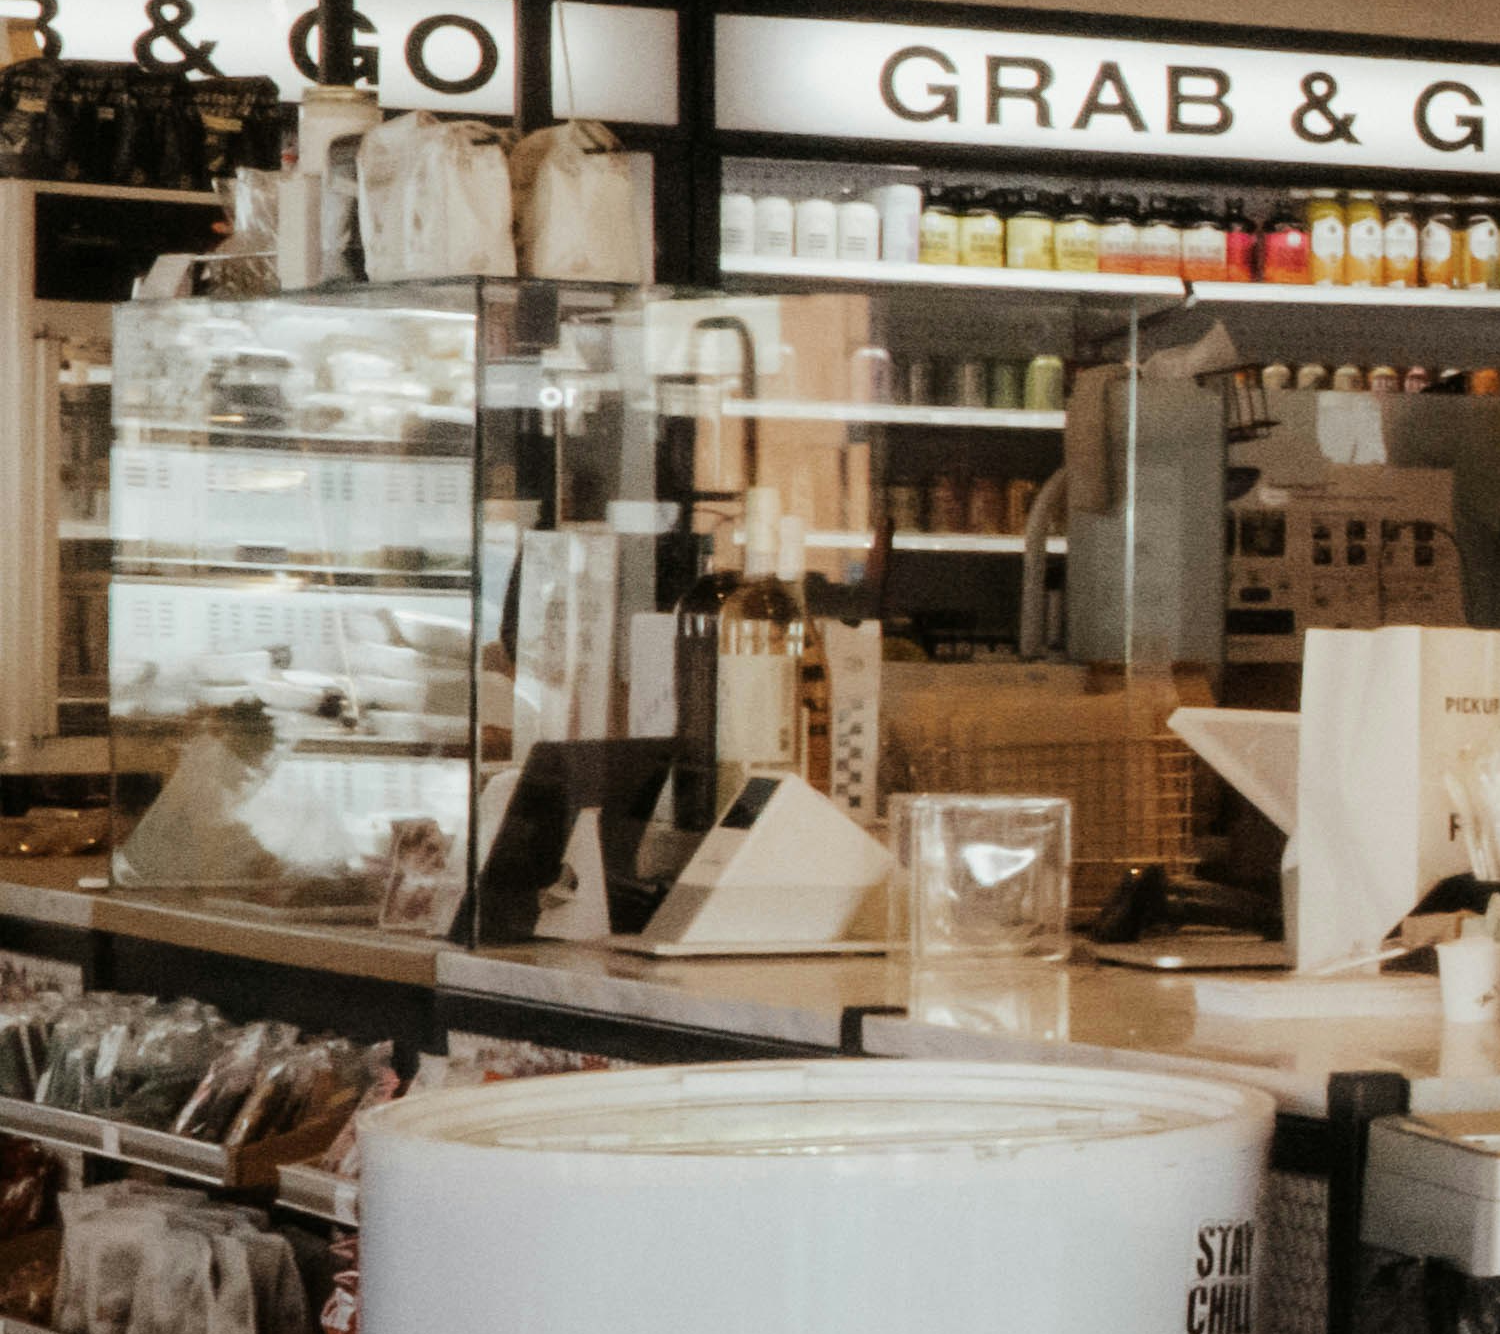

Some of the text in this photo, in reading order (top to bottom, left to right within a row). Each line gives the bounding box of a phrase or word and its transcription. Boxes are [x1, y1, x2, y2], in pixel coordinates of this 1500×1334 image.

[878, 44, 1235, 137] GRAB
[1291, 70, 1363, 147] &
[1445, 695, 1500, 715] PICKUP
[1197, 1220, 1254, 1280] STAY
